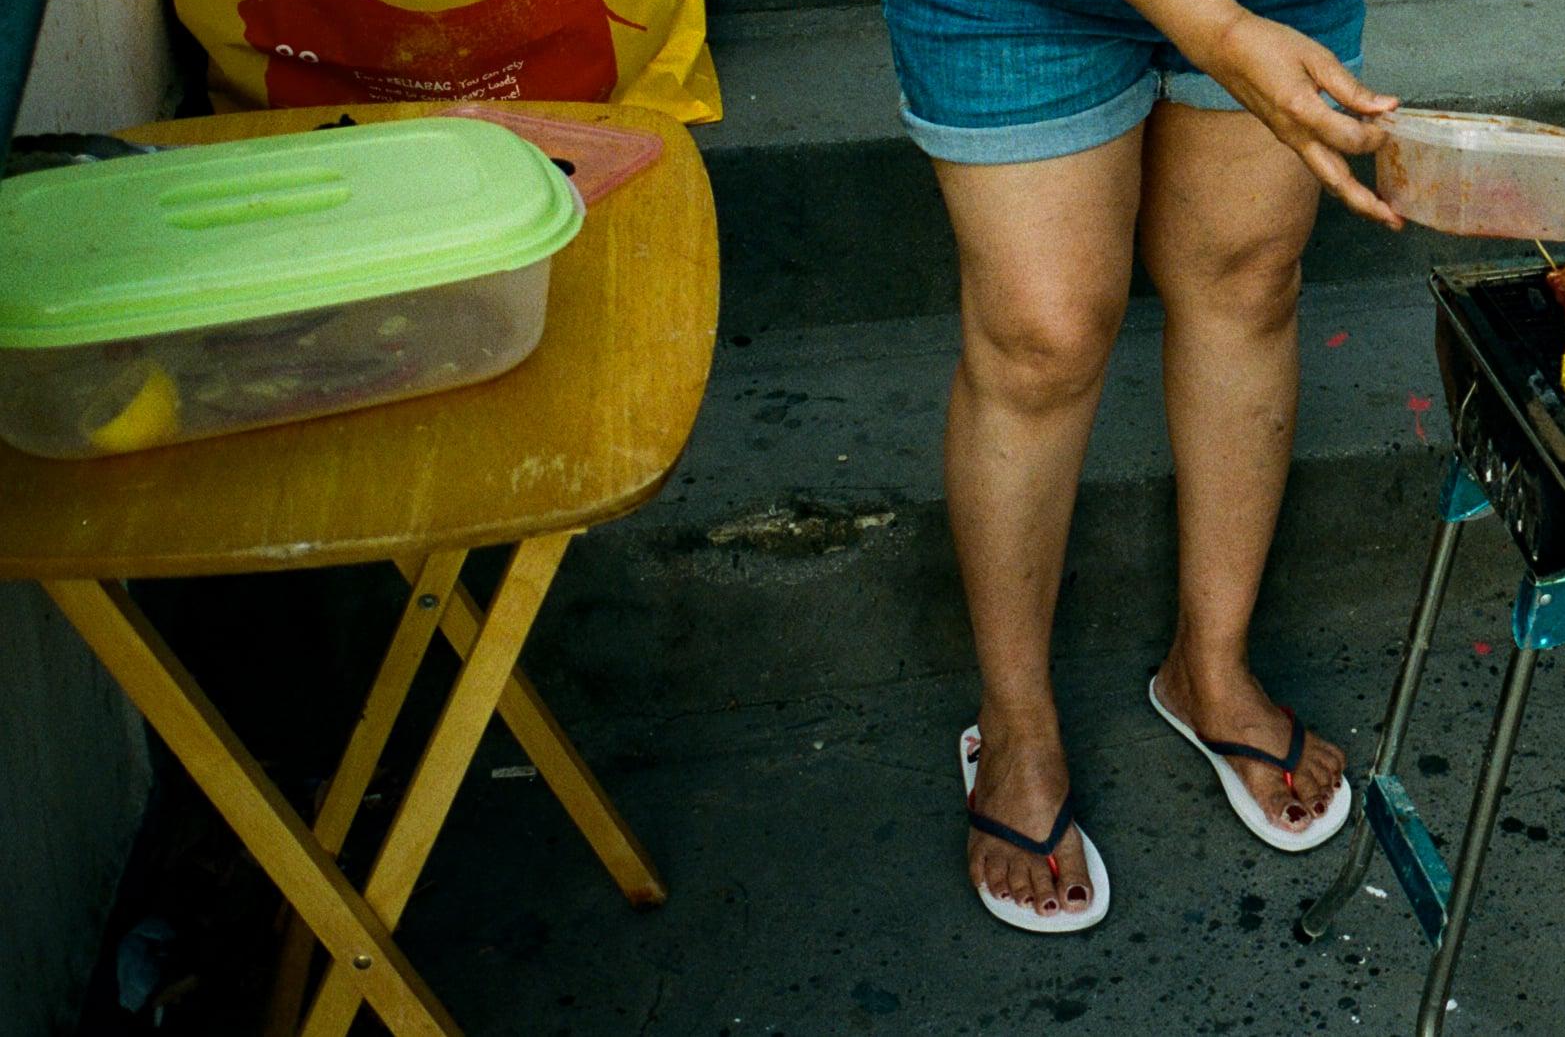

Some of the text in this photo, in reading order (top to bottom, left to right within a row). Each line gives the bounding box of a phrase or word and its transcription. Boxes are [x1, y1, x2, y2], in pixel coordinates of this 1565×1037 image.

[458, 78, 479, 90] You
[482, 70, 500, 81] can
[502, 60, 524, 73] rely
